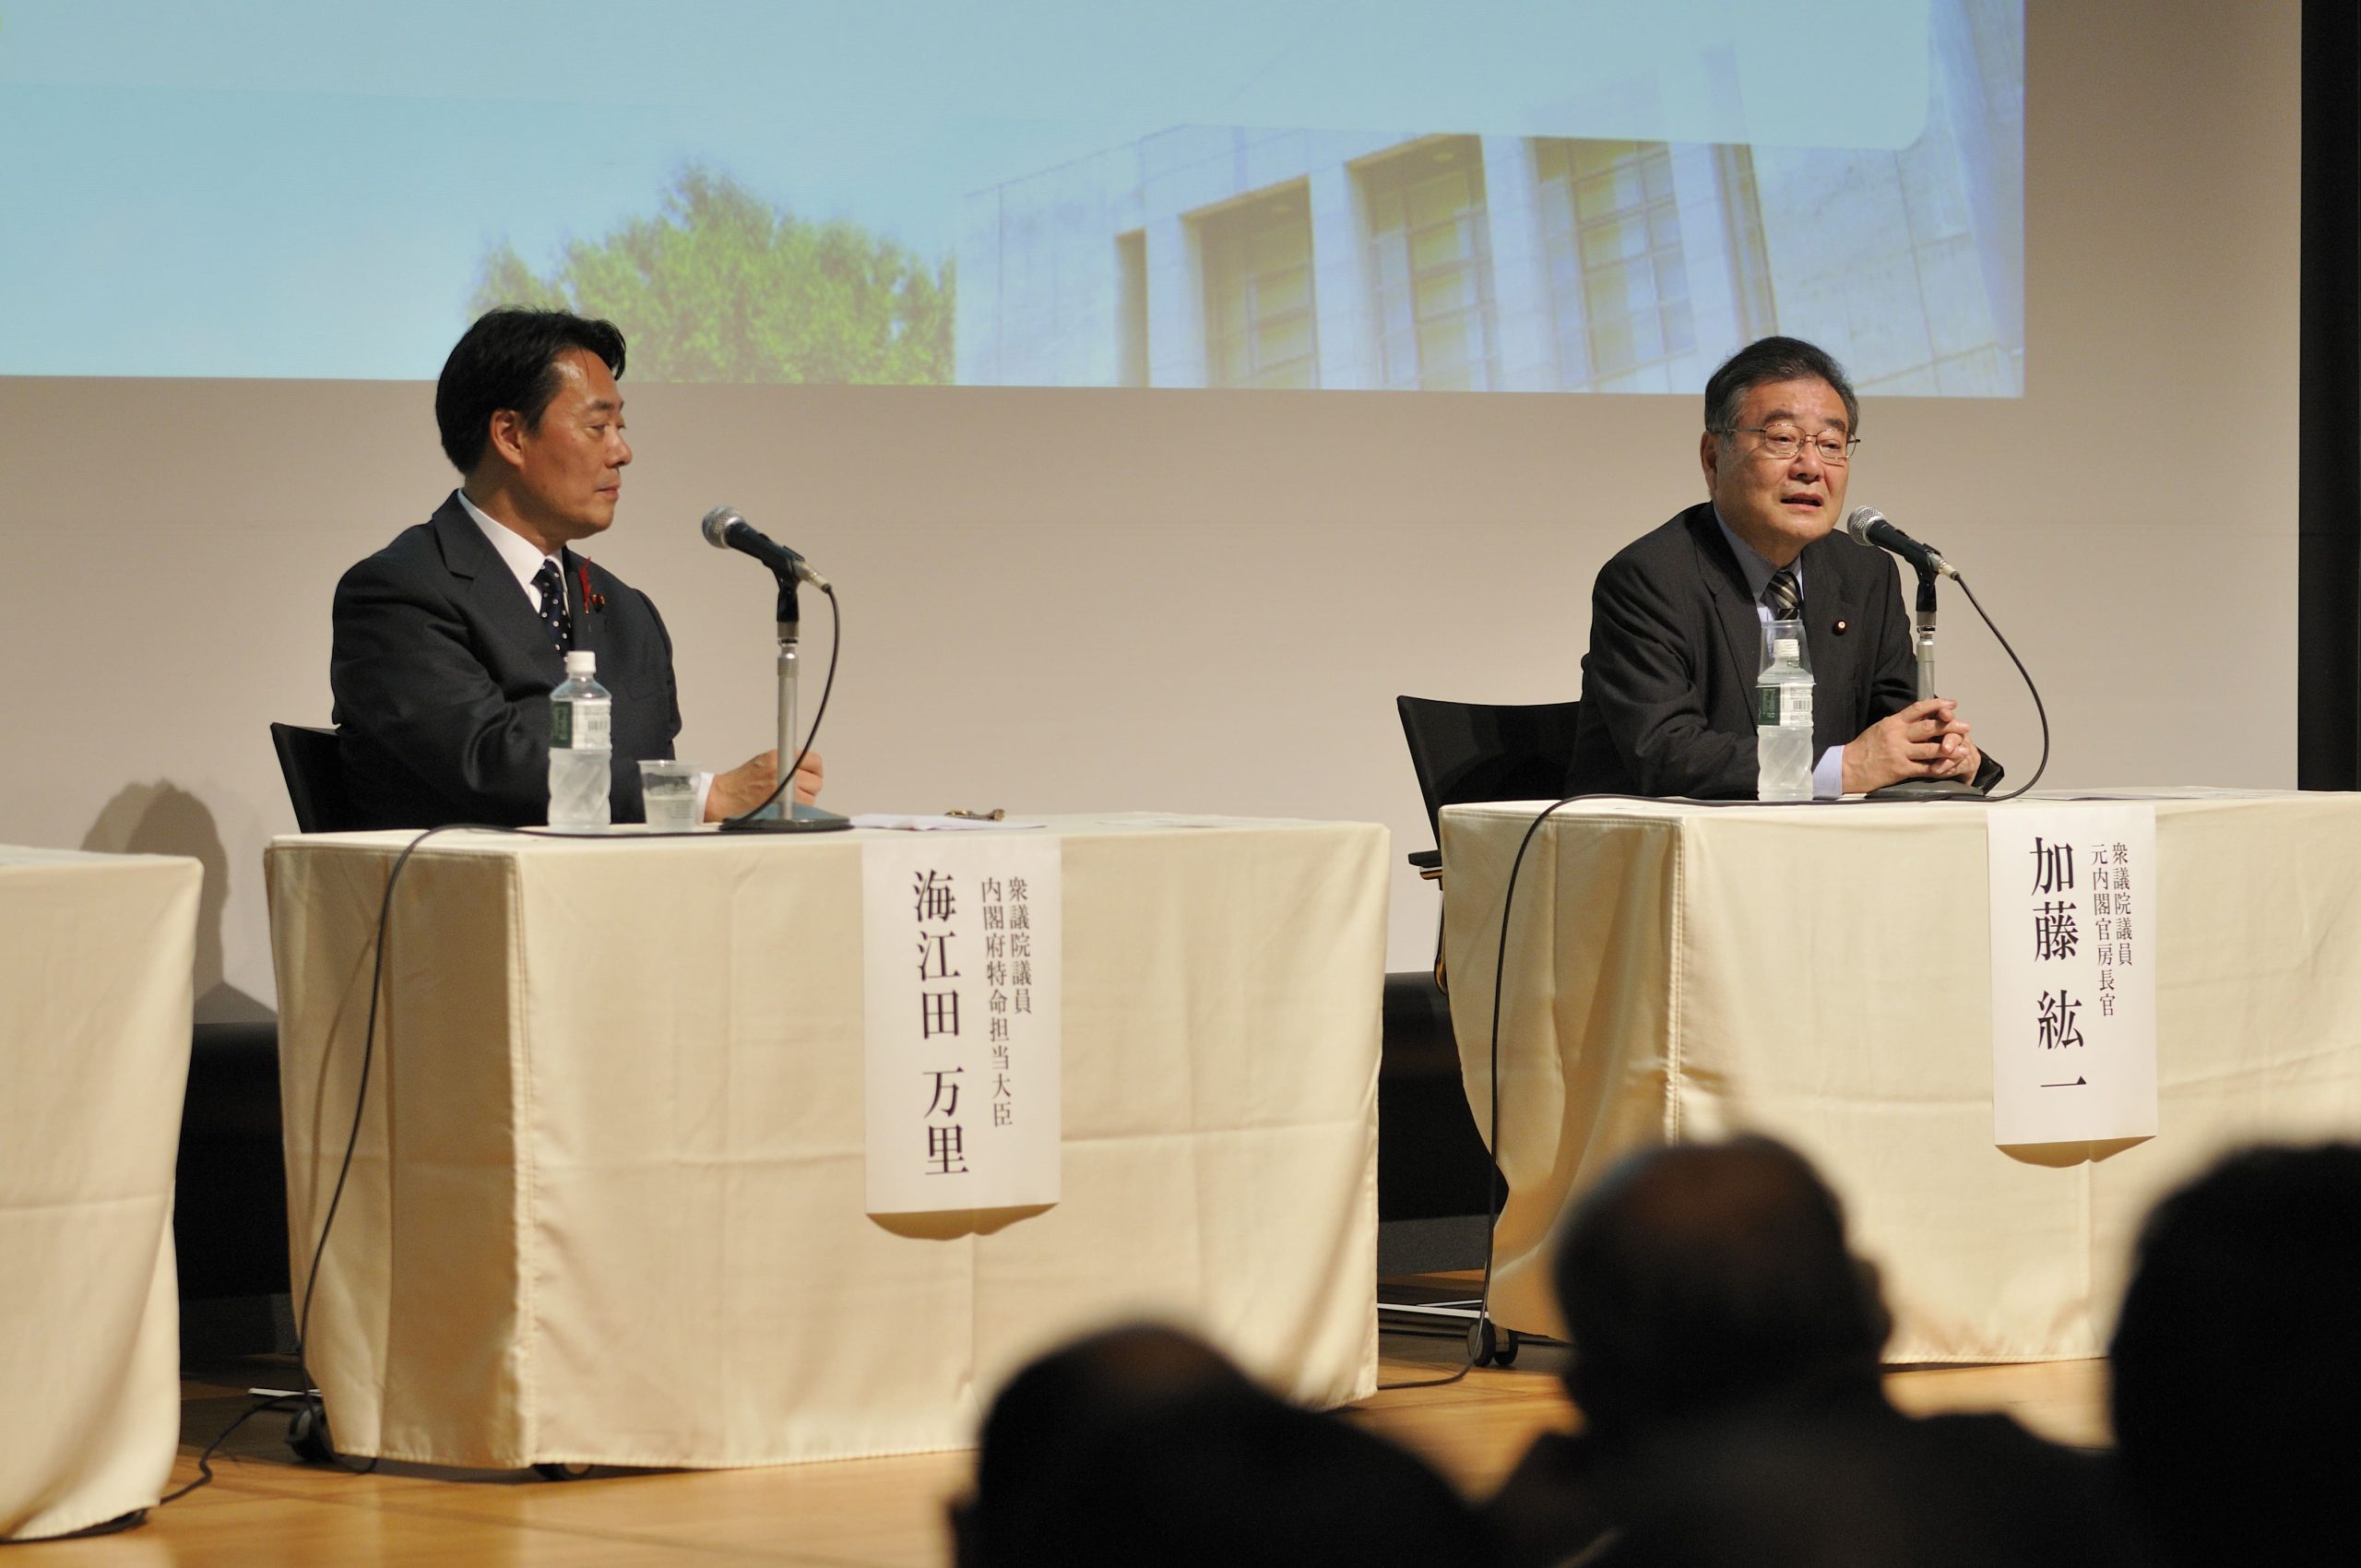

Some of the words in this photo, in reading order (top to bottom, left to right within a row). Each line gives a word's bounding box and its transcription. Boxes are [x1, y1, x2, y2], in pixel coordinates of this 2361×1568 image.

[913, 869, 961, 1040] 海江田
[1007, 876, 1032, 1016] 衆議院議員
[2029, 836, 2080, 963] 加藤
[2090, 842, 2117, 1017] 元内閣官房長官
[2112, 841, 2133, 967] 衆議院議員
[980, 876, 1013, 1128] 内閣府特命担当大臣
[2036, 989, 2087, 1087] 紘一
[923, 1066, 969, 1175] 万里
